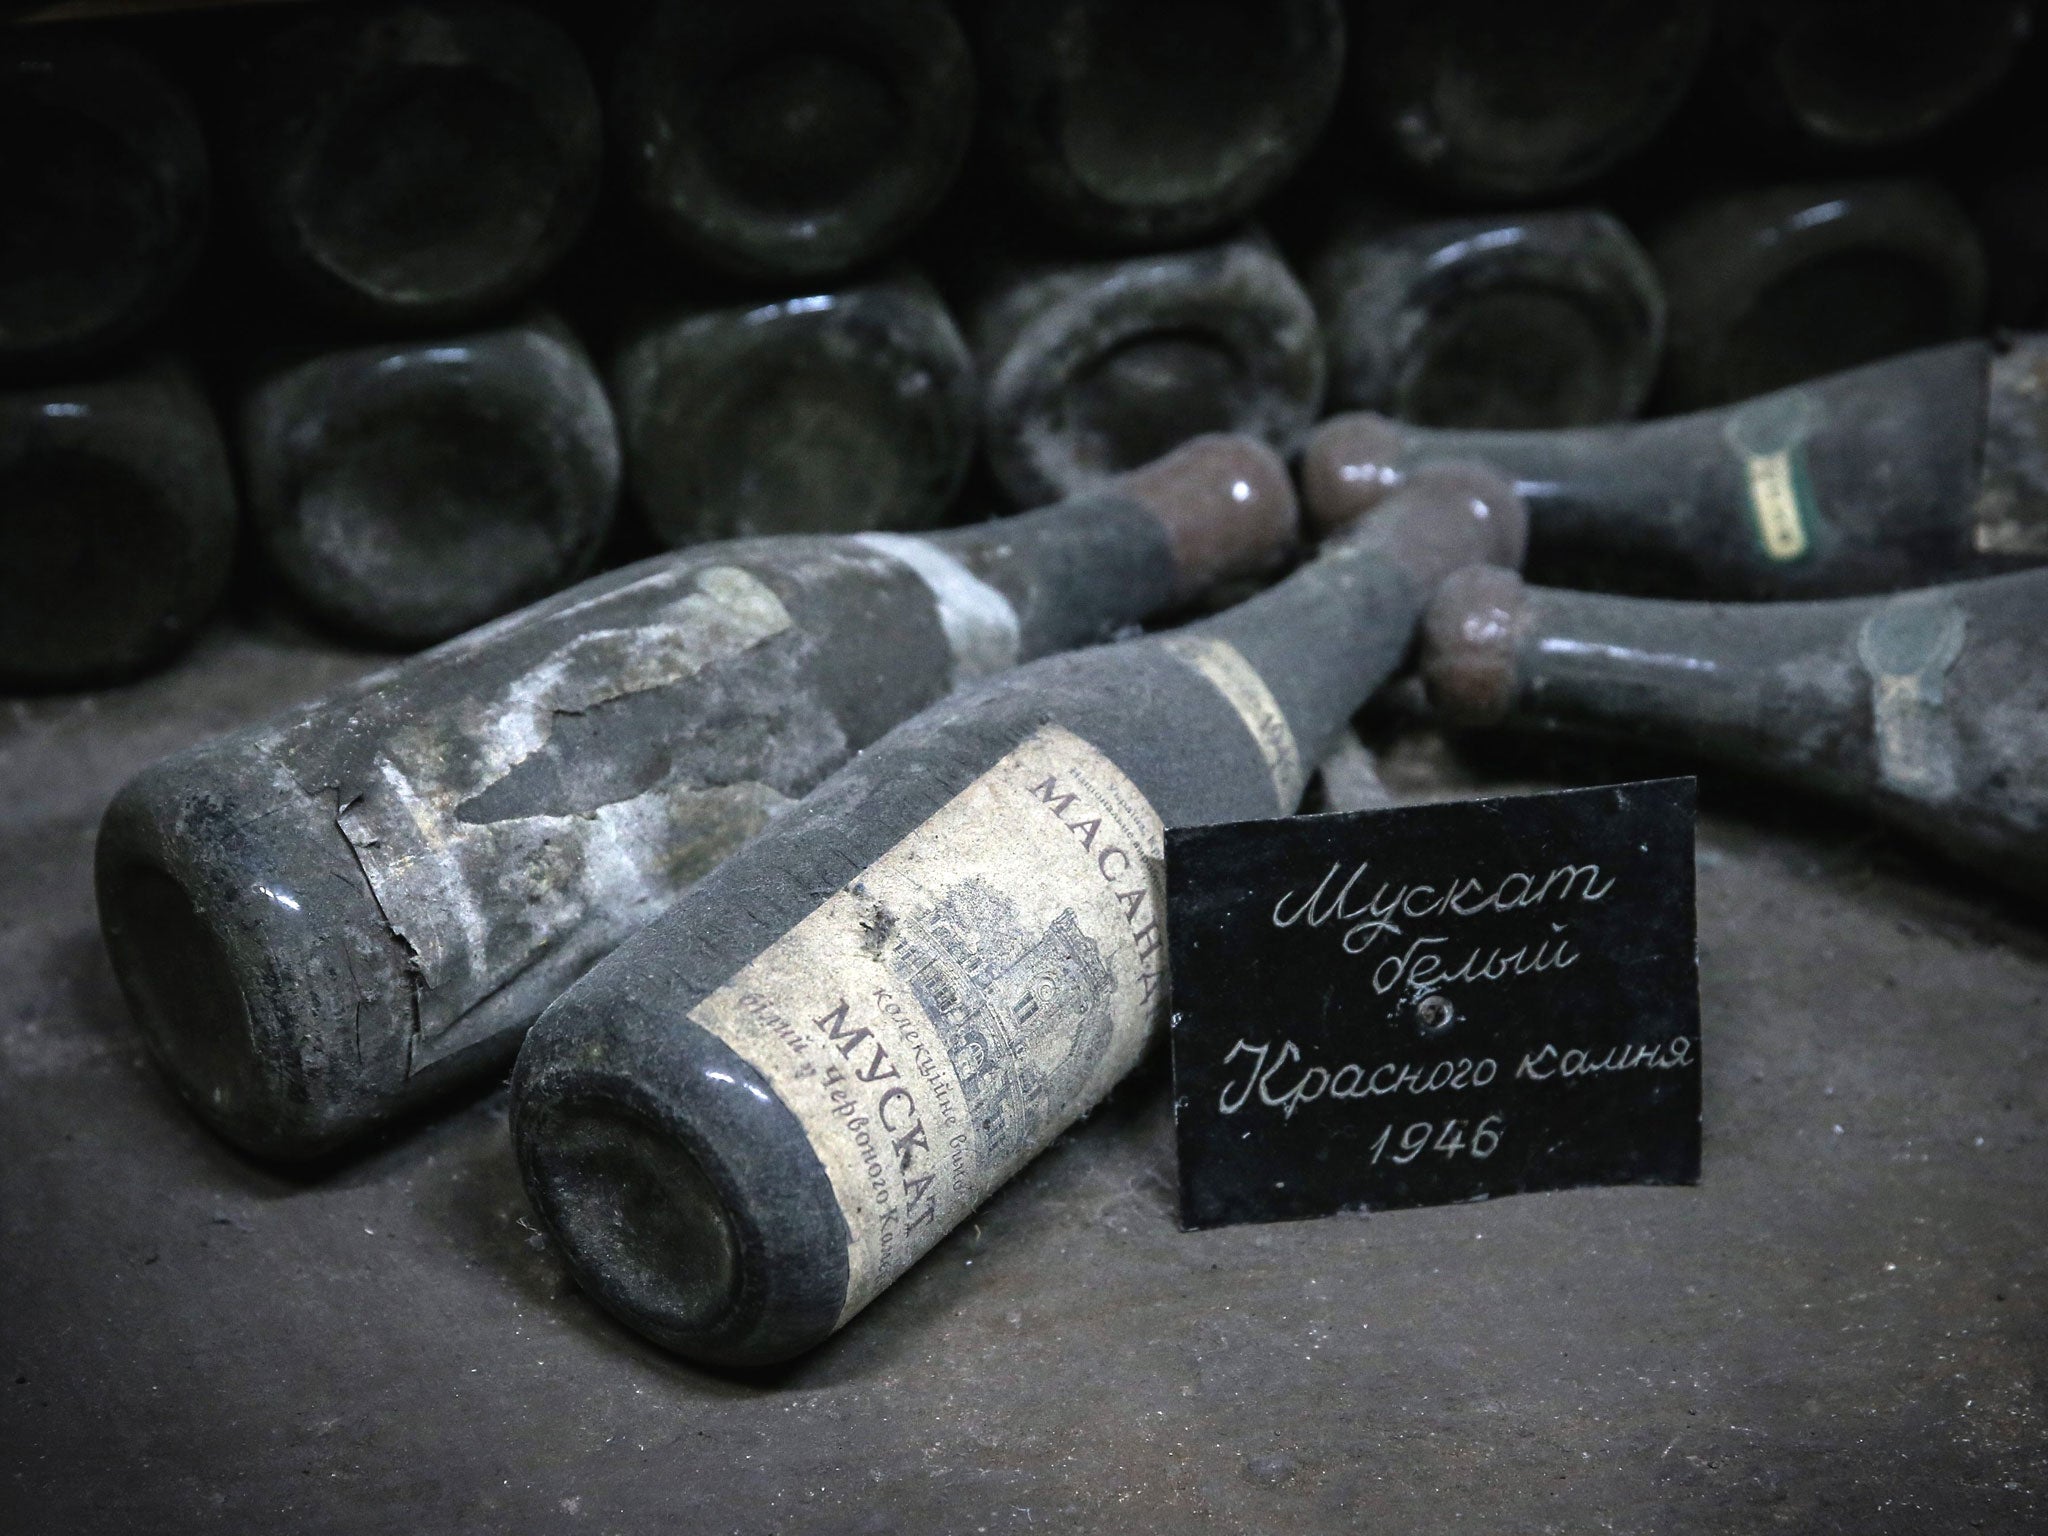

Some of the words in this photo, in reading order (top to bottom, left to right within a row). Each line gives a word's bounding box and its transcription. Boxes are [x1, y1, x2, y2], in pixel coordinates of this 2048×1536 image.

[1272, 860, 1616, 954] Мускат
[1371, 922, 1580, 995] белый
[736, 992, 812, 1055] білий
[823, 1063, 891, 1206] Червоного
[872, 986, 958, 1126] колекційне
[1218, 1038, 1498, 1119] Красного
[1515, 1035, 1695, 1081] камня
[812, 996, 940, 1239] МУСКАТ
[1370, 1114, 1502, 1167] 1946
